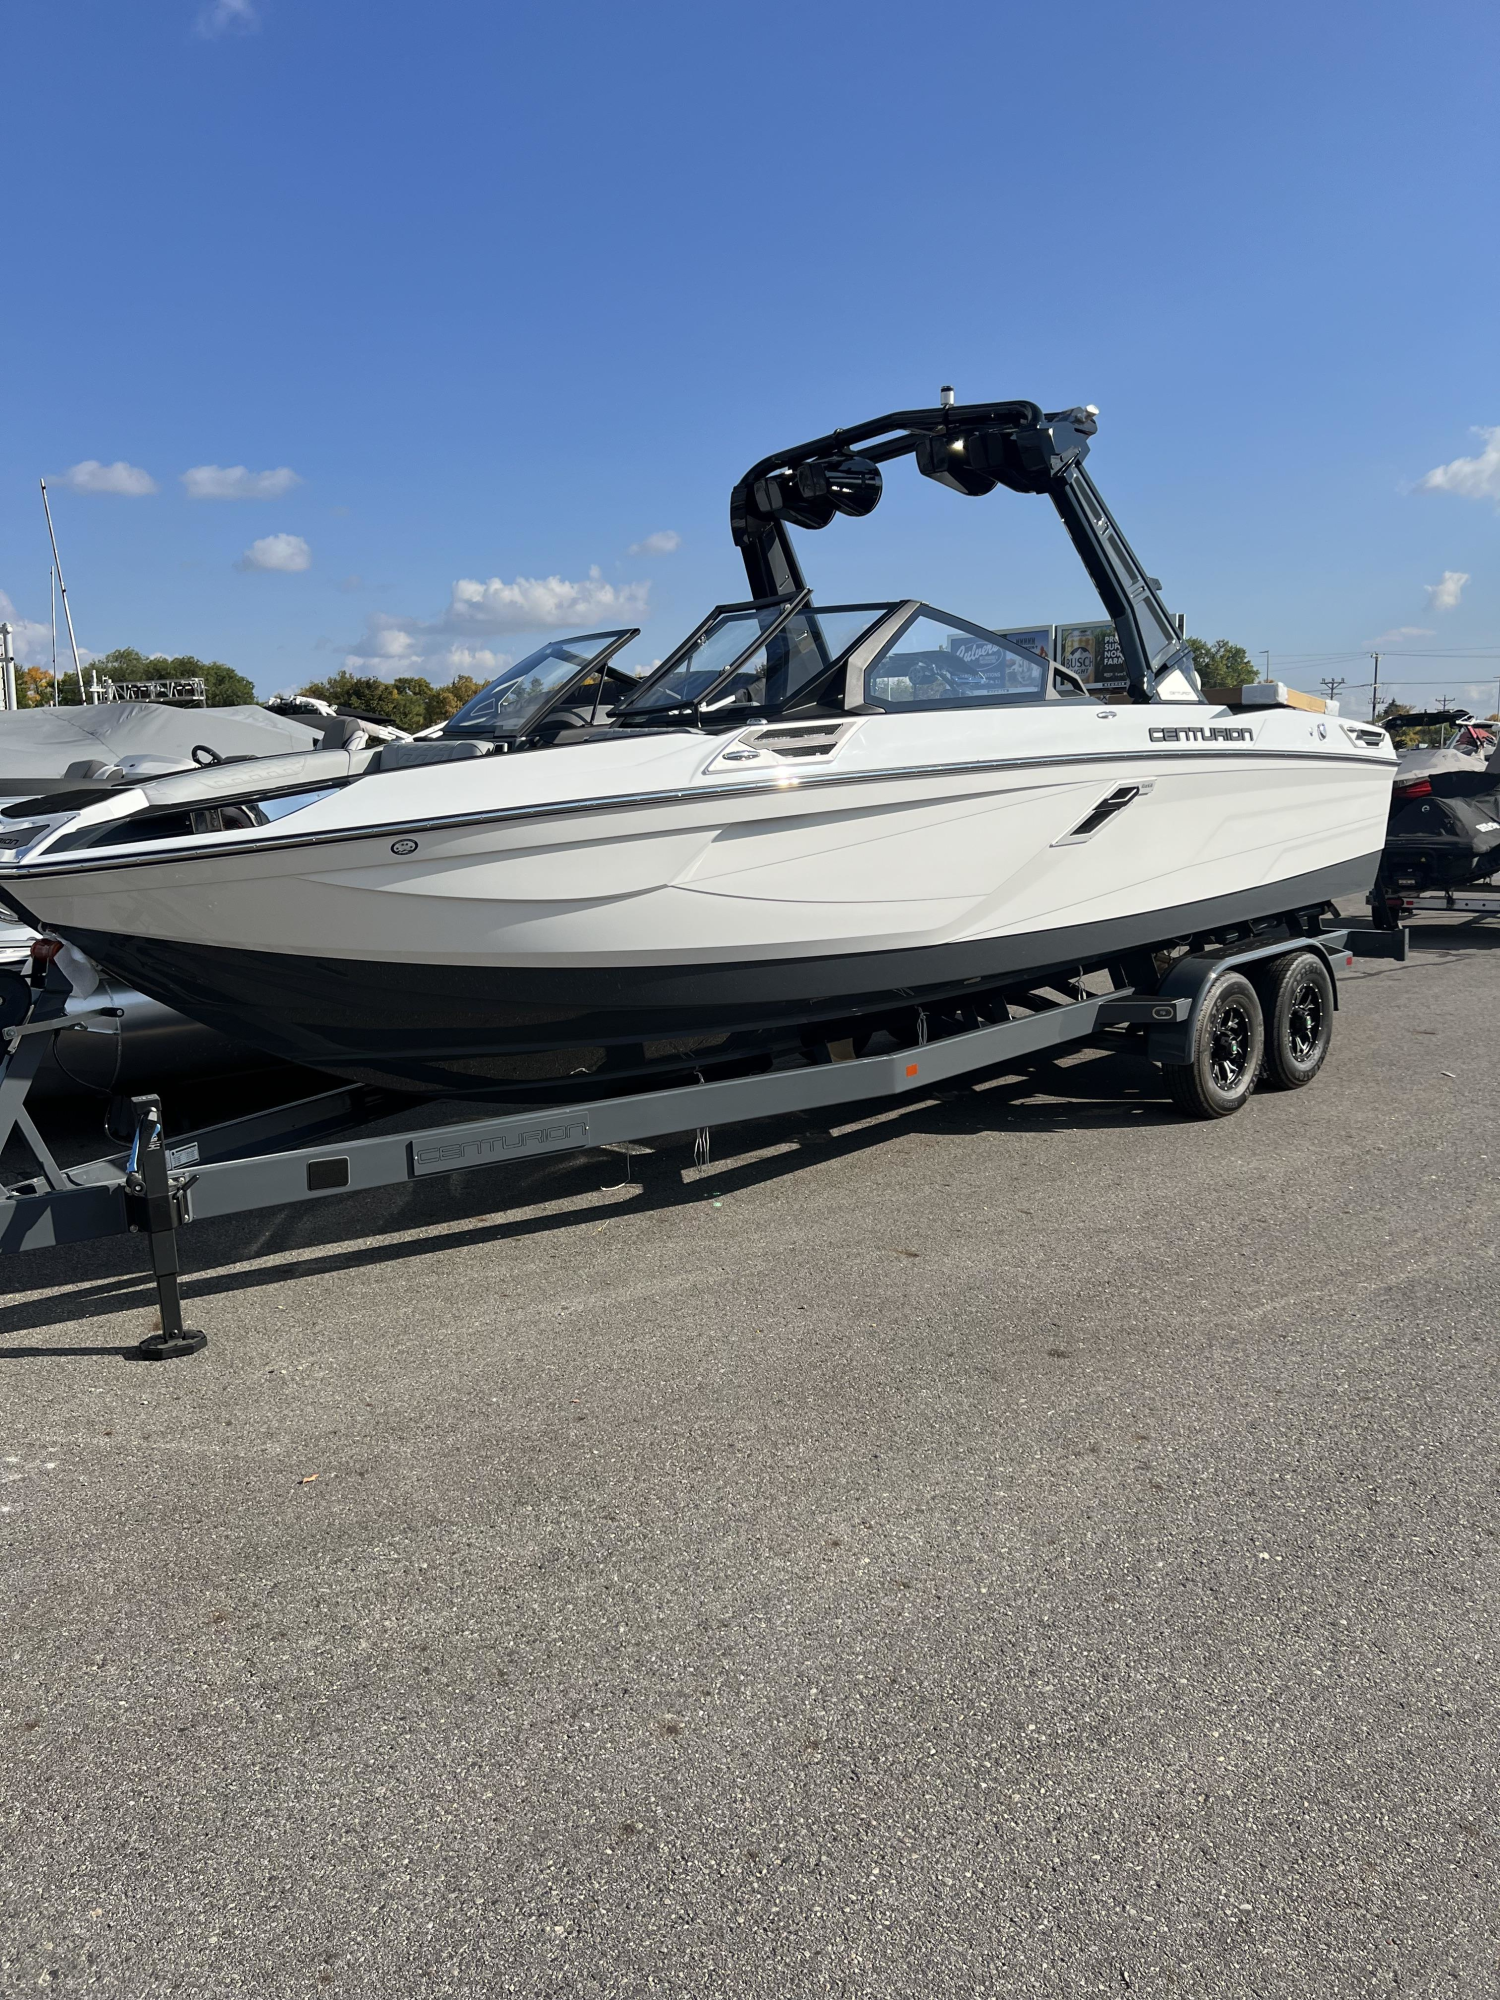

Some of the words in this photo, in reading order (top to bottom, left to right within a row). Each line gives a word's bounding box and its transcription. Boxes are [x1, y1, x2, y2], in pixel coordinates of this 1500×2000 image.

[1066, 656, 1094, 669] BUSCH
[1148, 727, 1254, 742] CENTURION
[417, 1122, 587, 1164] CENTURION
